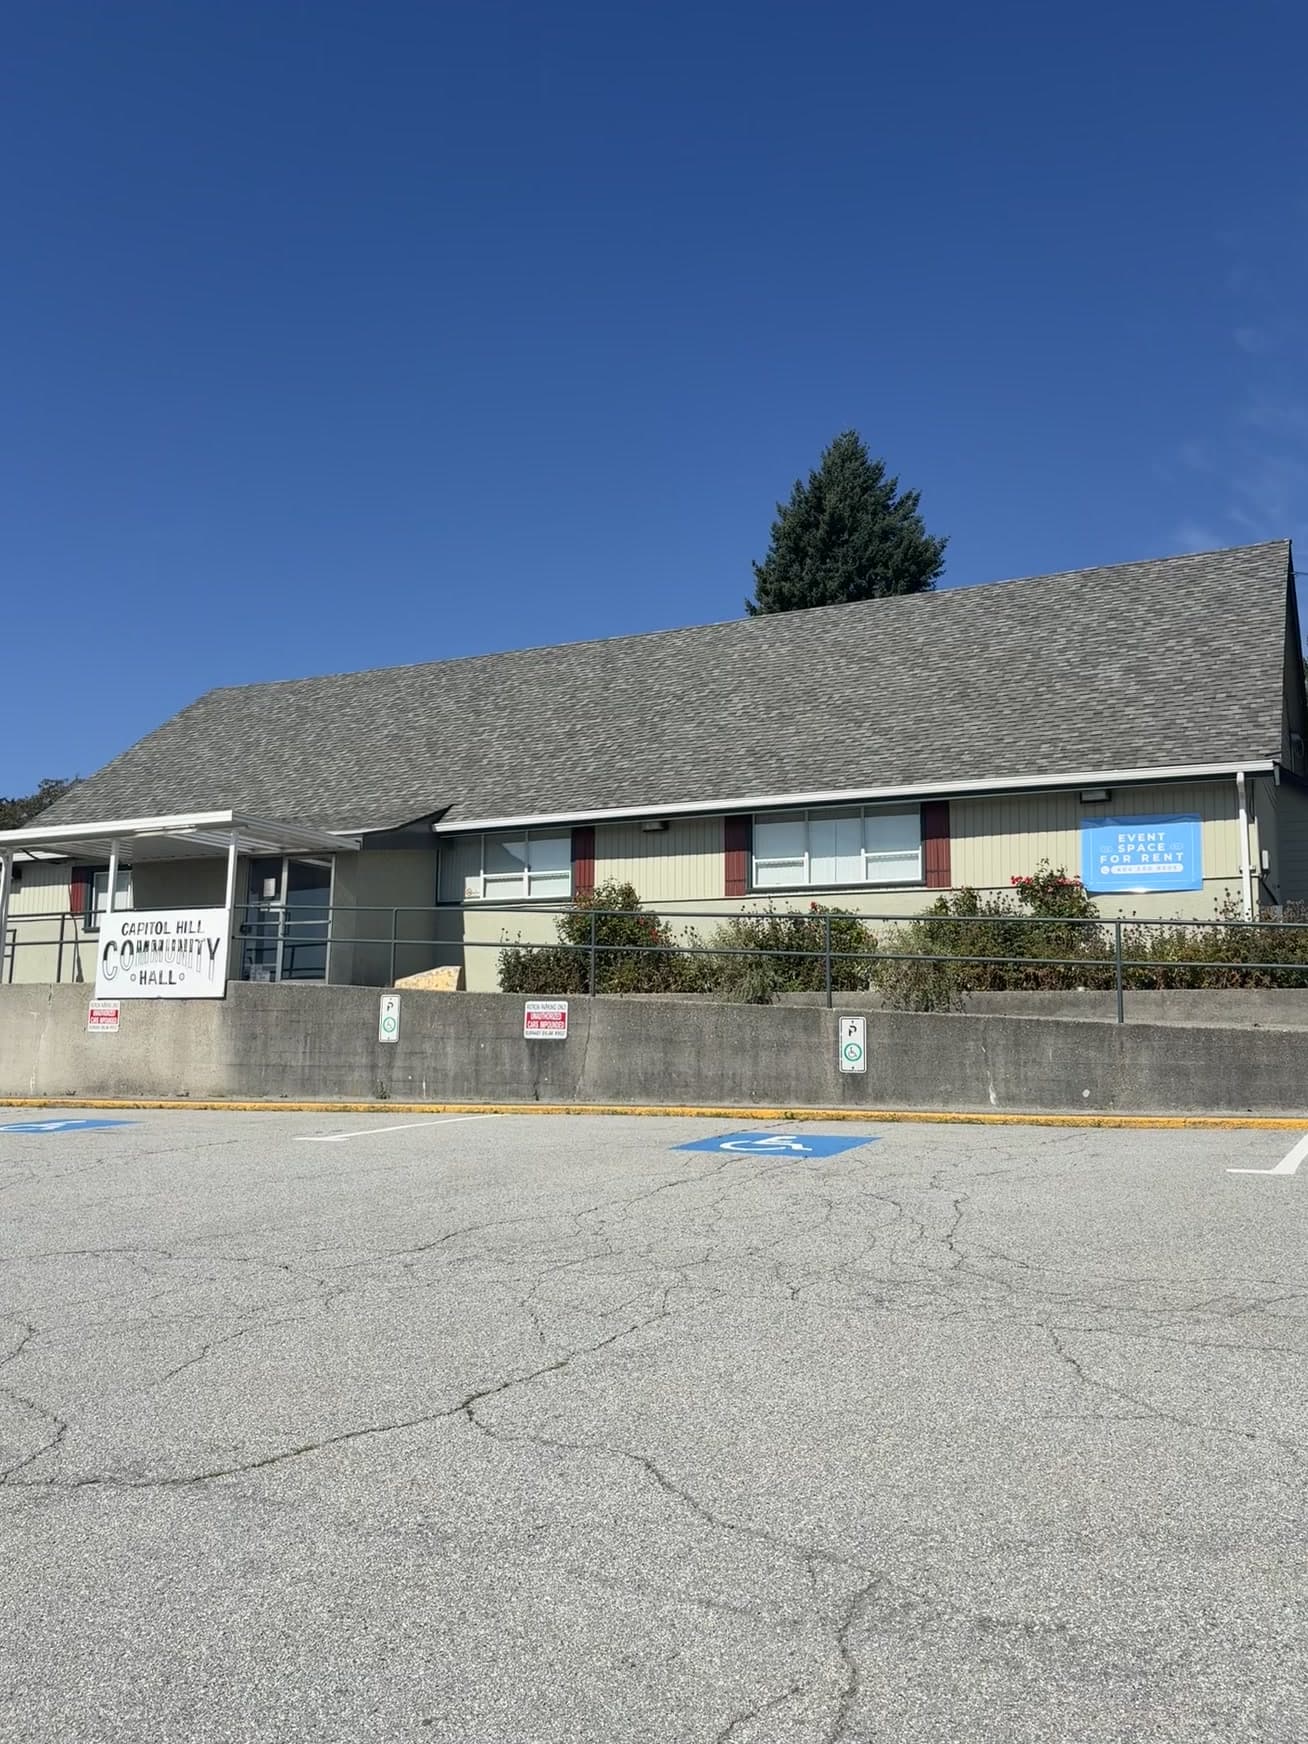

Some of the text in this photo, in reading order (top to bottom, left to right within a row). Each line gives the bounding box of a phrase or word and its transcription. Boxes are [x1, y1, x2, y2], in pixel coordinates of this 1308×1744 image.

[1118, 832, 1165, 843] EVENT
[1118, 842, 1165, 853] SPACE
[1100, 852, 1184, 864] FOR RENT
[121, 920, 205, 936] CAPITOL HILL
[102, 937, 220, 982] COMMUNITY
[139, 970, 177, 985] HALL
